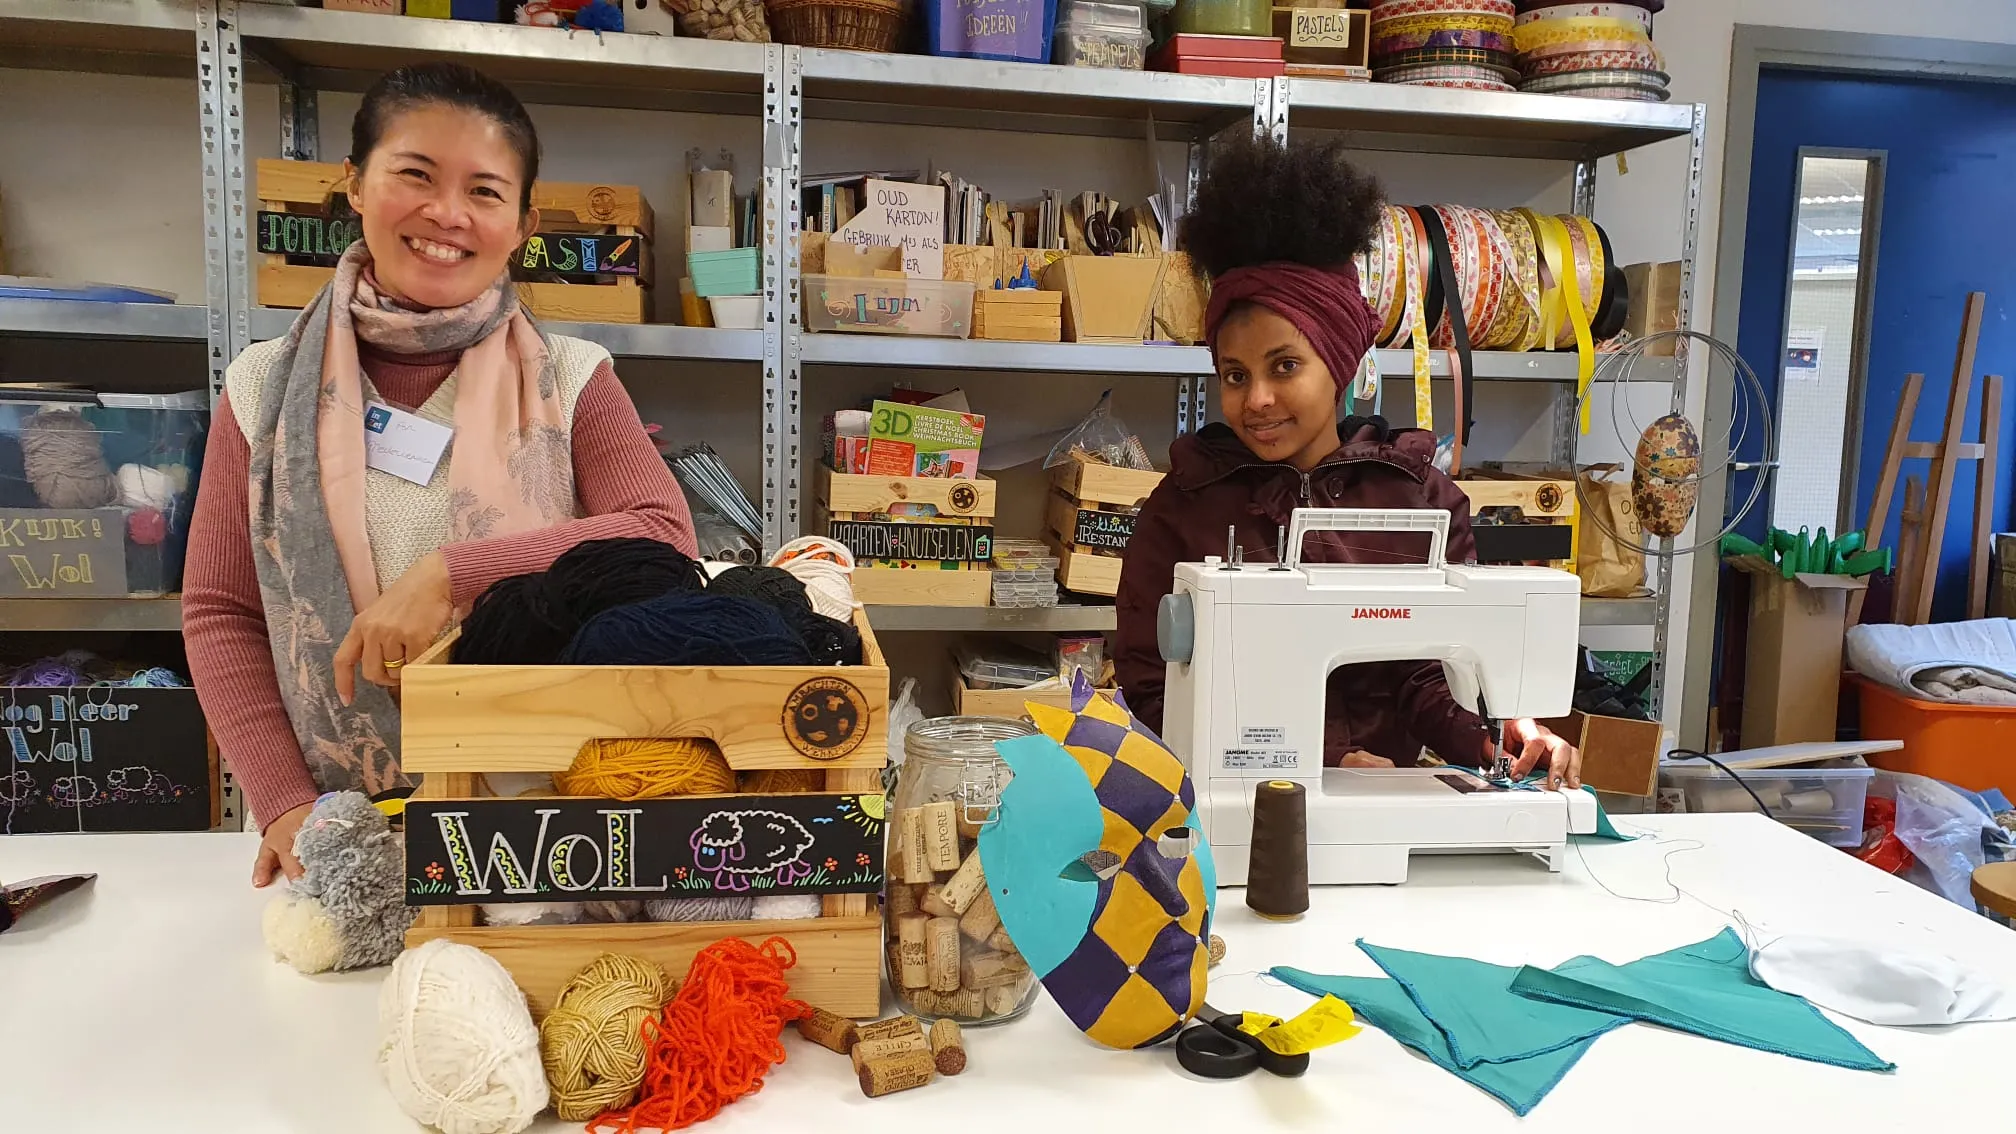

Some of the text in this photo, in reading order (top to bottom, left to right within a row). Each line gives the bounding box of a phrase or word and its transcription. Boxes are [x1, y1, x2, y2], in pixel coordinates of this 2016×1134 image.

[1296, 14, 1345, 35] PASTELS
[877, 189, 909, 206] OUD
[886, 208, 939, 227] KARTON!
[843, 227, 892, 247] GEBRUIK
[921, 237, 939, 250] ALS
[901, 257, 921, 275] ER
[873, 408, 912, 435] 3D
[914, 421, 934, 429] LIVRE
[915, 414, 954, 425] KERSTBOEK
[912, 432, 977, 447] WEIHNACHTSBUCH
[913, 426, 975, 440] CHRISTMAS BOOK
[898, 527, 974, 560] KNUTSELEN
[1351, 608, 1411, 619] JANOME
